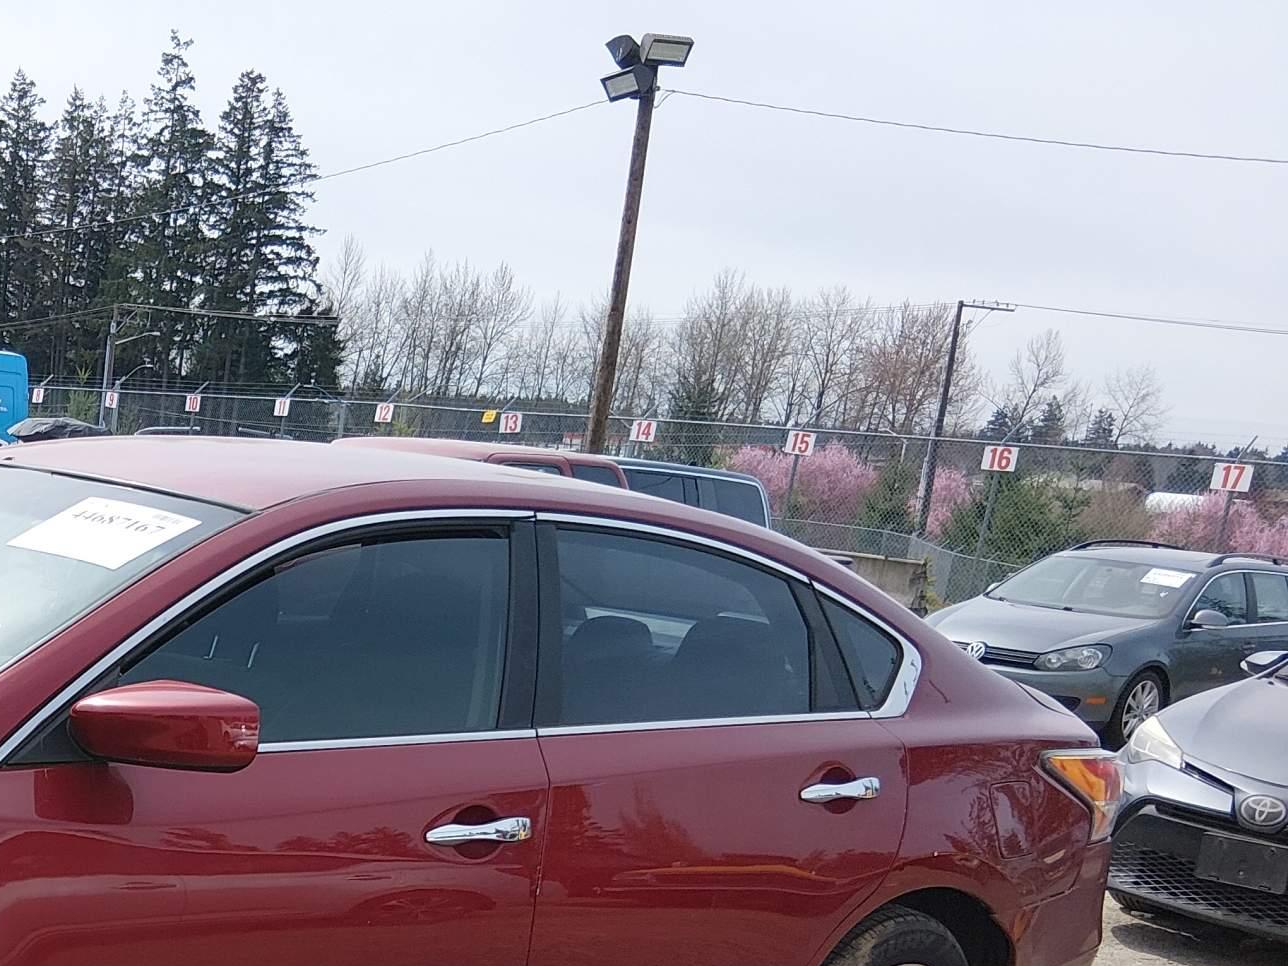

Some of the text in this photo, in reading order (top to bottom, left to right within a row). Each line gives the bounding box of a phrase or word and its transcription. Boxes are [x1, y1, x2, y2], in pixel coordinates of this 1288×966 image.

[108, 392, 115, 406] 9
[188, 396, 199, 411] 10
[278, 400, 286, 415] 11
[379, 405, 391, 421] 12
[503, 414, 518, 432] 13
[635, 421, 651, 440] 14
[791, 432, 811, 453] 15
[988, 447, 1012, 470] 16
[1220, 465, 1246, 489] 17
[72, 510, 166, 534] 44687167
